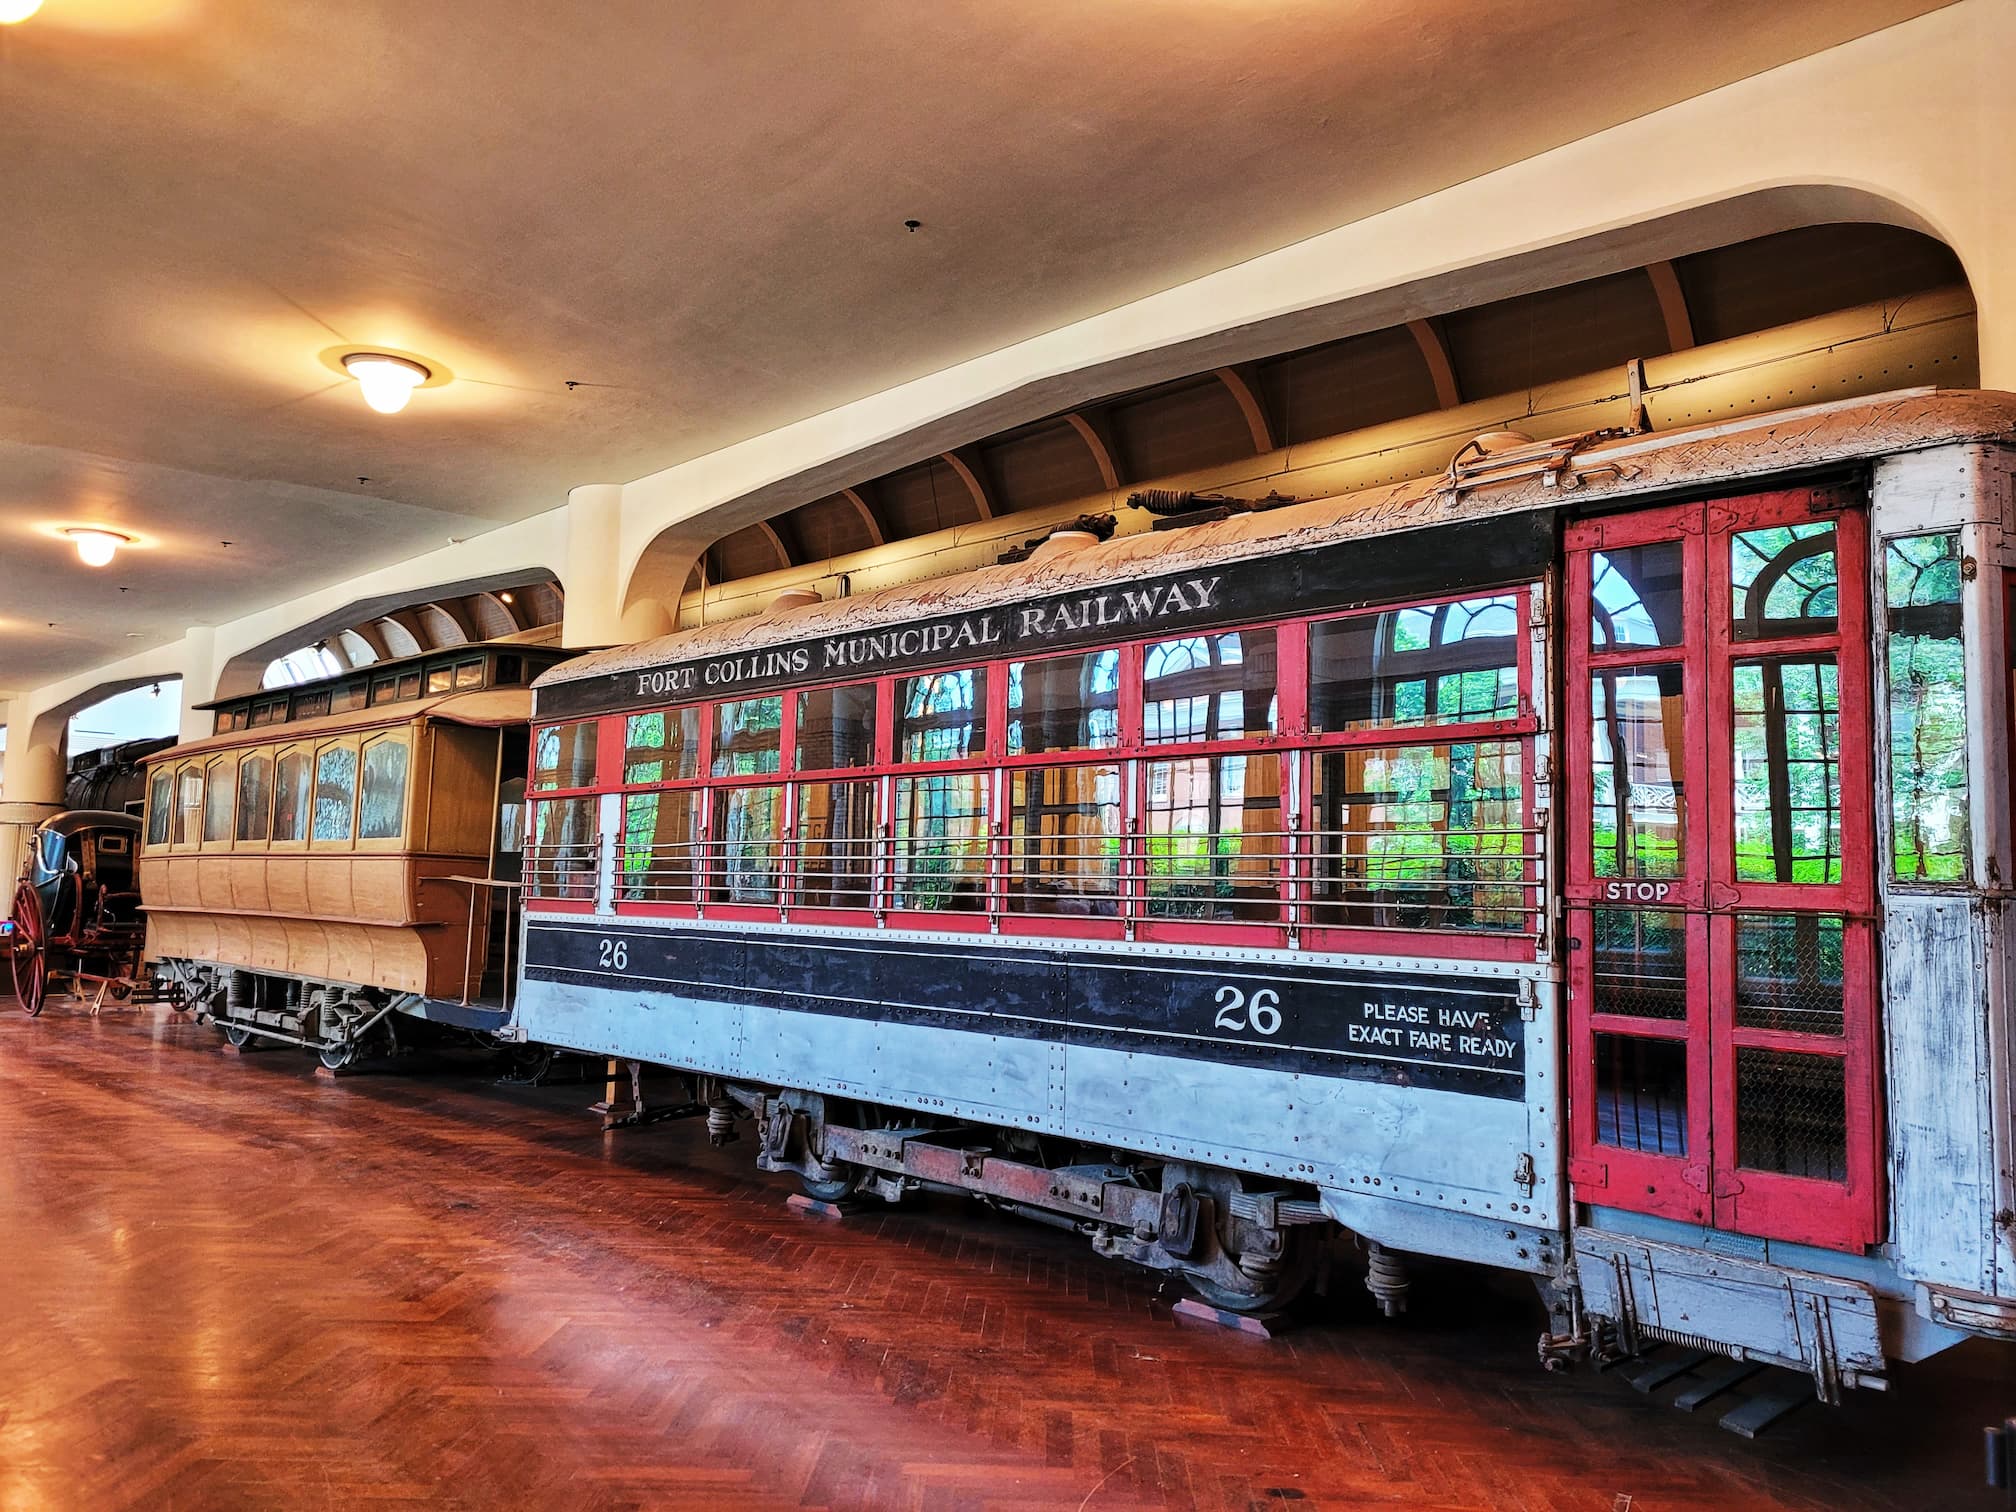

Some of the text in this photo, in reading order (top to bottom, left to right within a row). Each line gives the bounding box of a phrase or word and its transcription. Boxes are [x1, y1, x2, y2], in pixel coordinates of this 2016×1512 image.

[636, 576, 1222, 695] FORT COLLINS MUNICIPAL RAILWAY
[1606, 882, 1670, 901] STOP
[599, 939, 628, 970] 26
[1214, 985, 1282, 1036] 26
[1363, 1002, 1430, 1025] PLEASE
[1348, 1023, 1517, 1059] EXACT FARE READY
